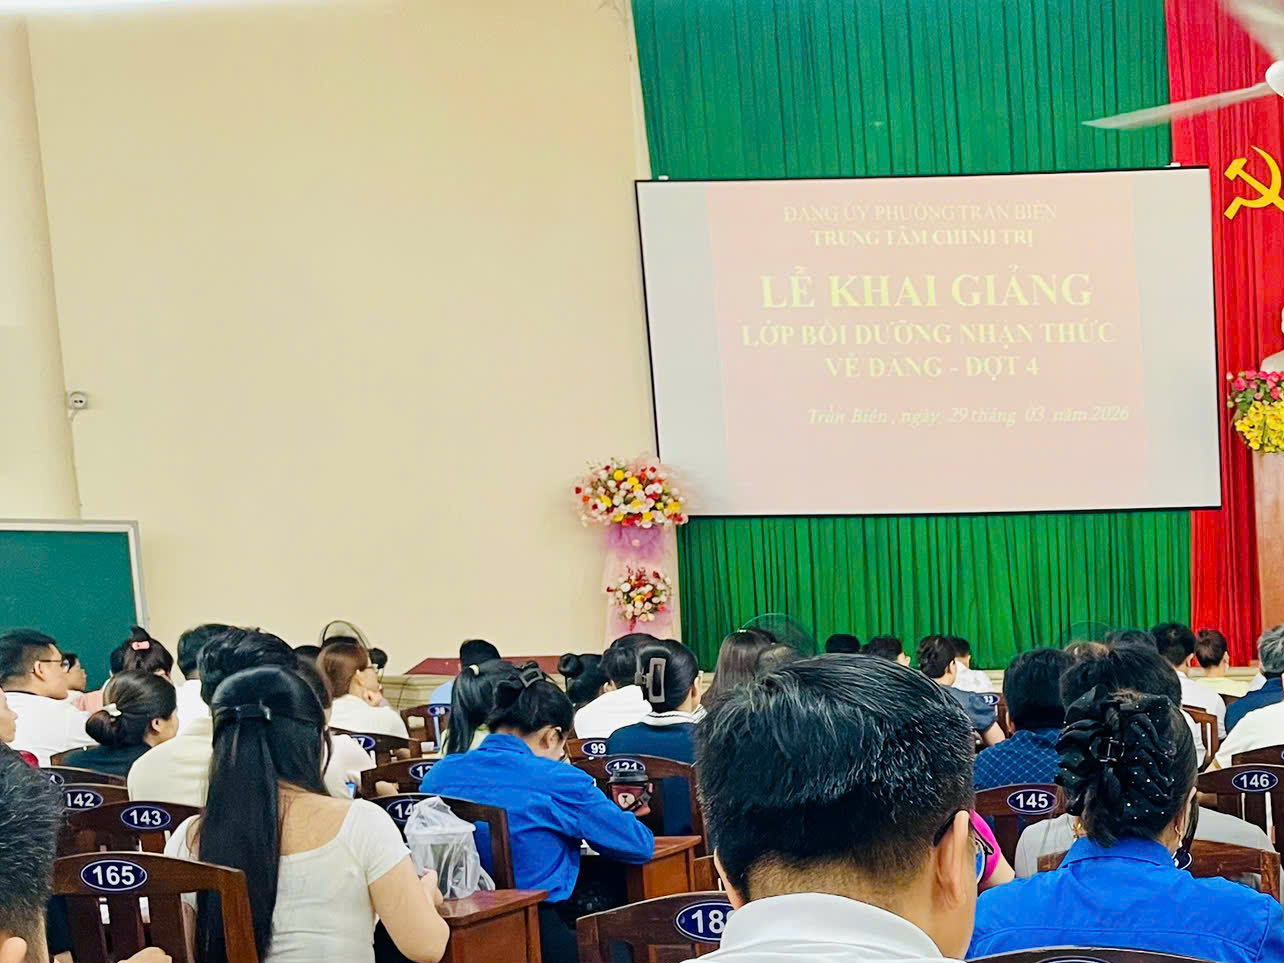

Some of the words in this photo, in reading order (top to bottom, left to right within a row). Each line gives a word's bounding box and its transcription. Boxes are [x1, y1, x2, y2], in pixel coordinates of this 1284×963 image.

[812, 229, 880, 246] TRUNG
[886, 225, 928, 246] TÂM
[760, 266, 815, 308] LỄ
[829, 273, 937, 308] KHAI
[951, 264, 1092, 308] GIẢNG
[742, 318, 795, 348] LỚP
[801, 317, 846, 346] BỒI
[856, 318, 951, 346] DƯỠNG
[960, 320, 1033, 350] NHẬN
[1042, 316, 1115, 344] THỨC
[966, 354, 1019, 381] ĐỢT
[1025, 356, 1040, 377] 4
[591, 743, 606, 754] 99
[1240, 774, 1269, 788] 146
[1016, 793, 1048, 808] 145
[130, 810, 161, 825] 143
[92, 865, 135, 886] 165
[692, 909, 731, 934] 18
